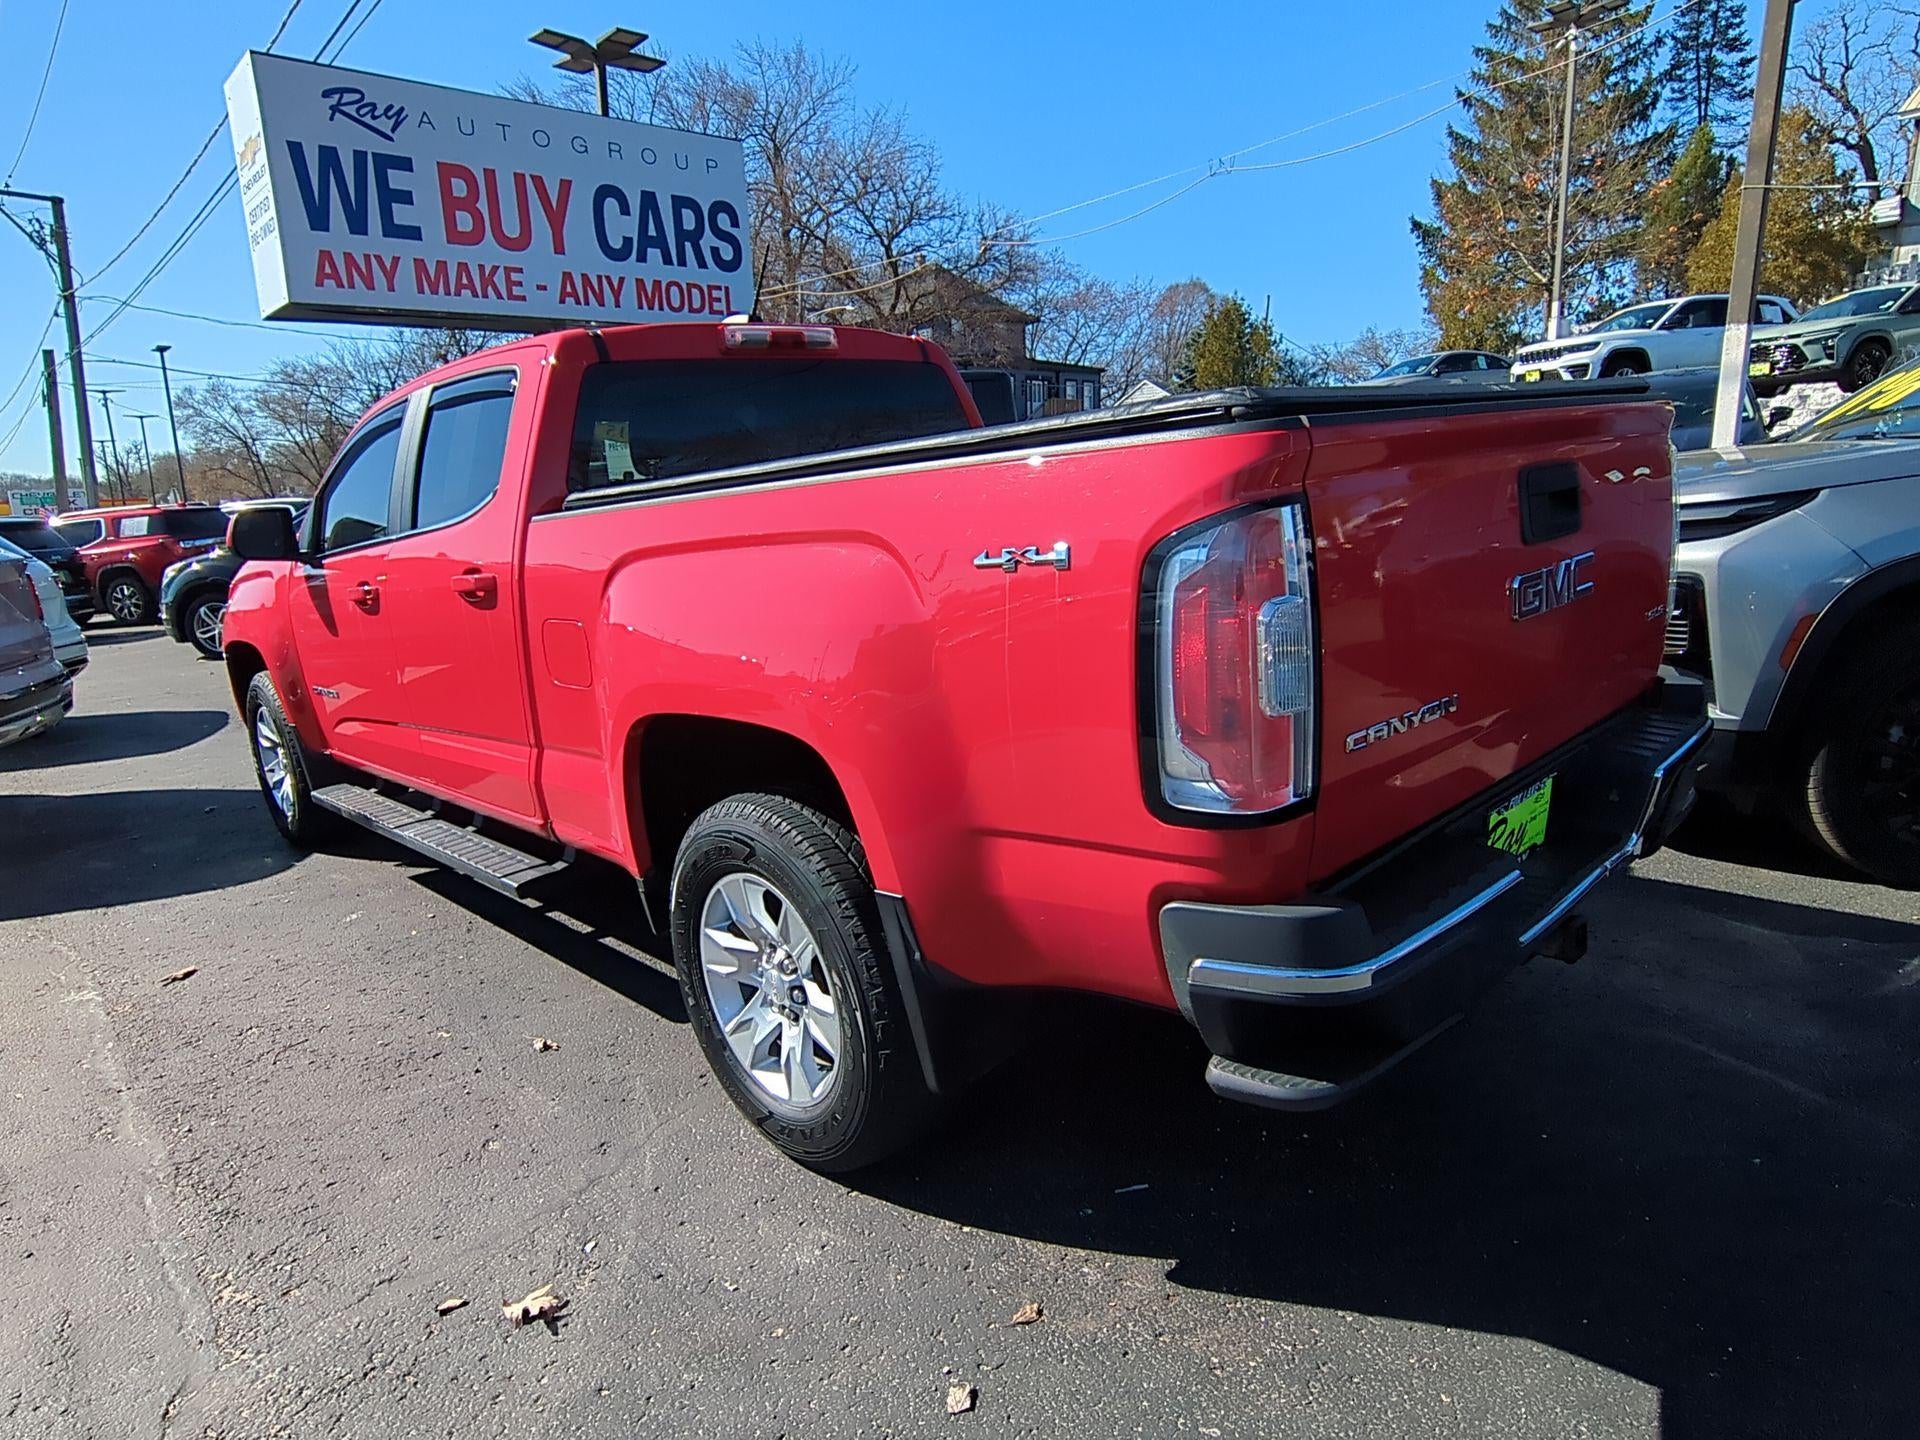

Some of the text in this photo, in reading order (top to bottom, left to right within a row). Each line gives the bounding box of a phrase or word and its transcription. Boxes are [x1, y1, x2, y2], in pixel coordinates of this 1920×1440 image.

[320, 86, 718, 174] Ray AUTOGROUP
[286, 139, 743, 273] WE BUY CARS
[315, 249, 401, 292] ANY
[413, 257, 528, 302] MAKE
[558, 271, 626, 308] ANY
[635, 277, 738, 316] MODEL
[1511, 550, 1595, 621] GMC
[1345, 693, 1459, 753] CANYON
